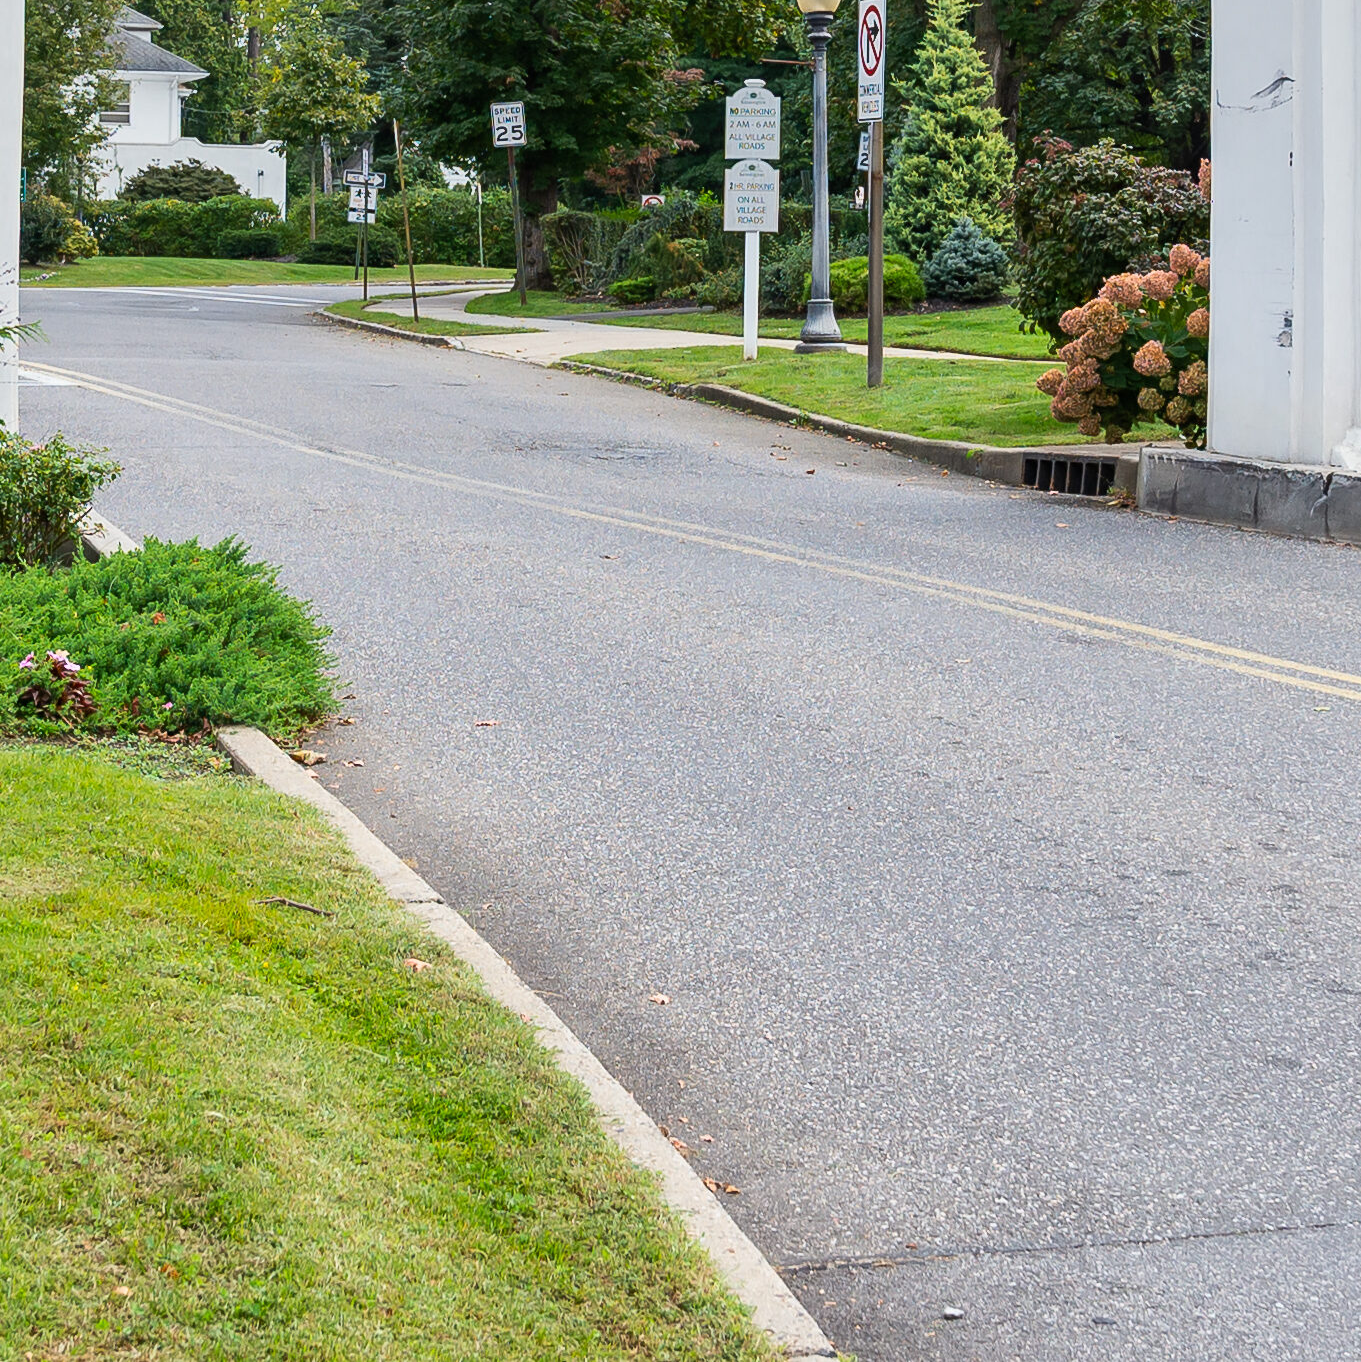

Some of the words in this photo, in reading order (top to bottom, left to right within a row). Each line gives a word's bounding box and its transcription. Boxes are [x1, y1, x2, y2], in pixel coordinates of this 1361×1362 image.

[494, 107, 521, 115] SPEED
[729, 107, 739, 115] NO
[497, 116, 518, 124] LIMIT
[729, 120, 735, 128] 2
[736, 120, 750, 128] AM
[755, 120, 761, 128] 6
[763, 120, 776, 128] AM
[496, 125, 523, 141] 25
[744, 133, 776, 141] VILLAGE
[738, 142, 765, 150] ROADS
[736, 206, 766, 214] VILLAGE
[737, 216, 764, 224] ROADS
